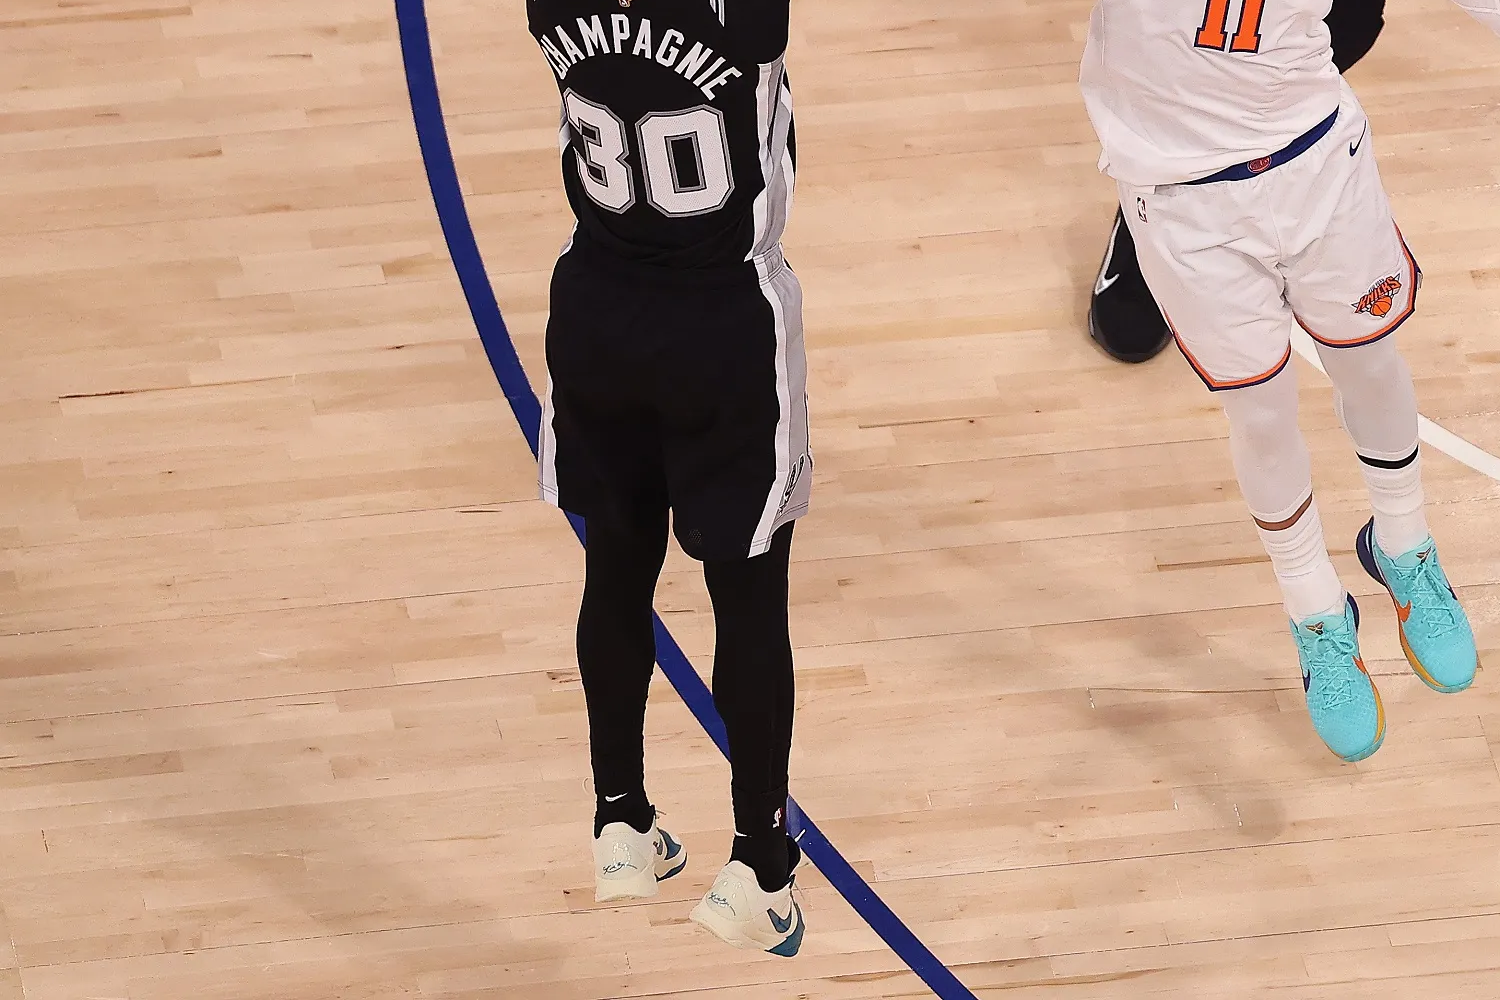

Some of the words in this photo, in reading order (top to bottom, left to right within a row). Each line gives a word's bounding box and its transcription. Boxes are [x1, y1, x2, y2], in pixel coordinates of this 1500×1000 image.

[540, 13, 743, 101] CHAMPAGNIE
[562, 86, 736, 219] 30
[1354, 276, 1402, 314] KNICKS
